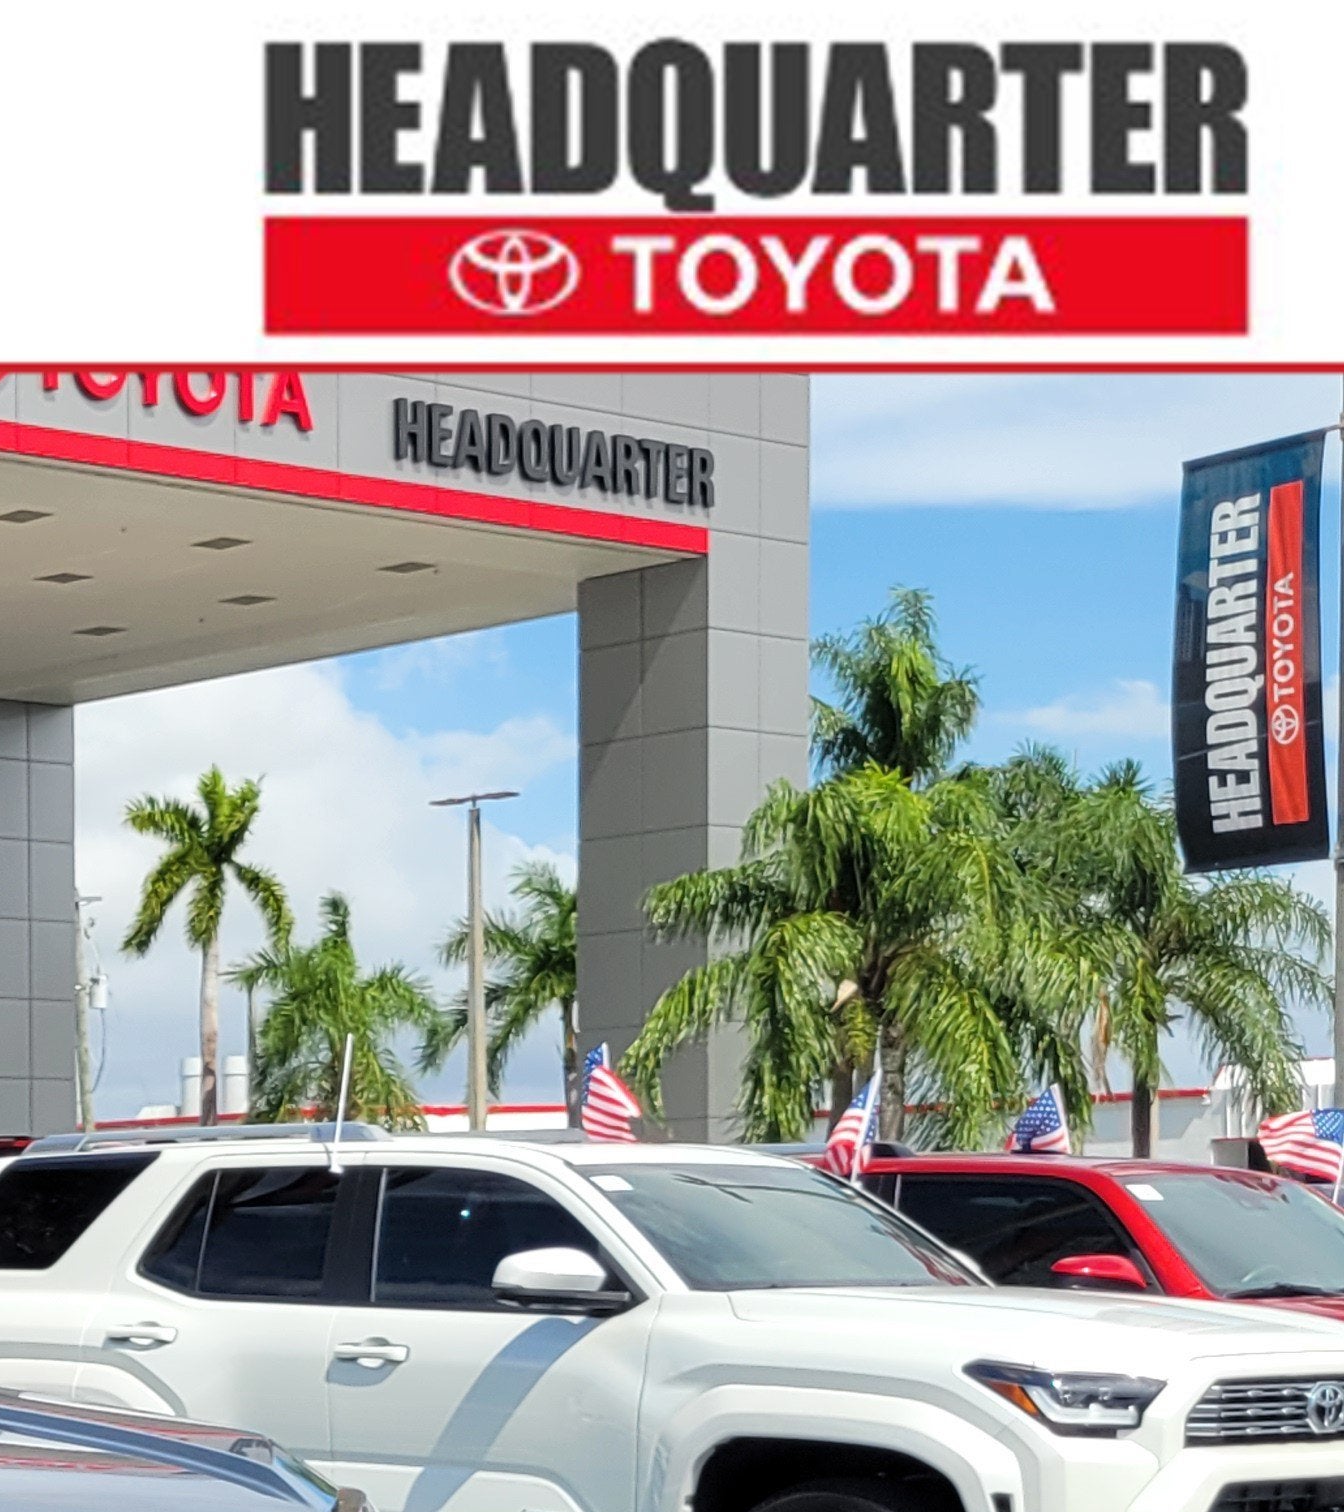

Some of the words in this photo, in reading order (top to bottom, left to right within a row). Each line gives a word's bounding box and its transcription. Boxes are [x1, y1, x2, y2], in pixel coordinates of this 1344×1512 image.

[43, 372, 313, 432] OTA
[393, 397, 715, 508] HEADQUARTER
[1205, 492, 1263, 834] HEADQUARTER
[1272, 571, 1295, 703] TOYOTA
